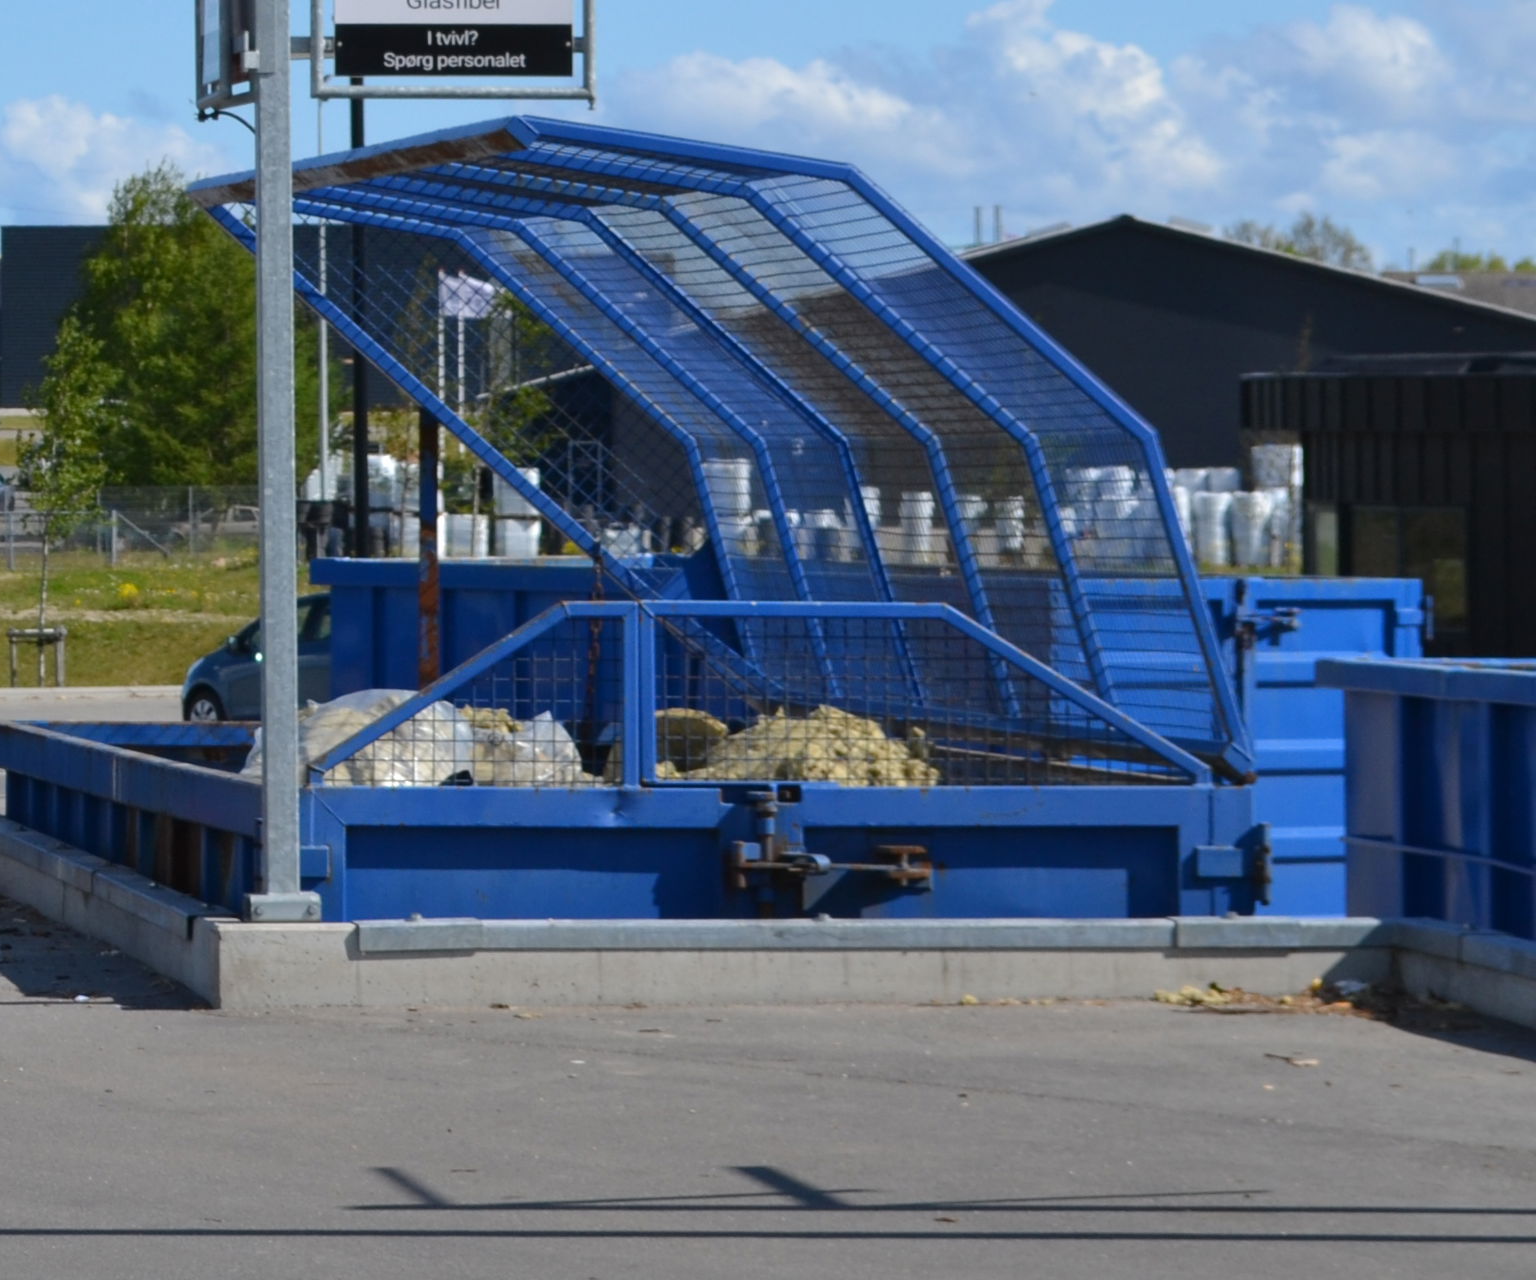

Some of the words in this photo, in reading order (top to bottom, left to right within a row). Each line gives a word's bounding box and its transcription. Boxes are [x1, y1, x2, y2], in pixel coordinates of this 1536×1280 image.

[427, 31, 432, 46] I
[435, 30, 479, 46] tvivl?
[383, 52, 434, 70] Spørg
[437, 52, 527, 70] personalet
